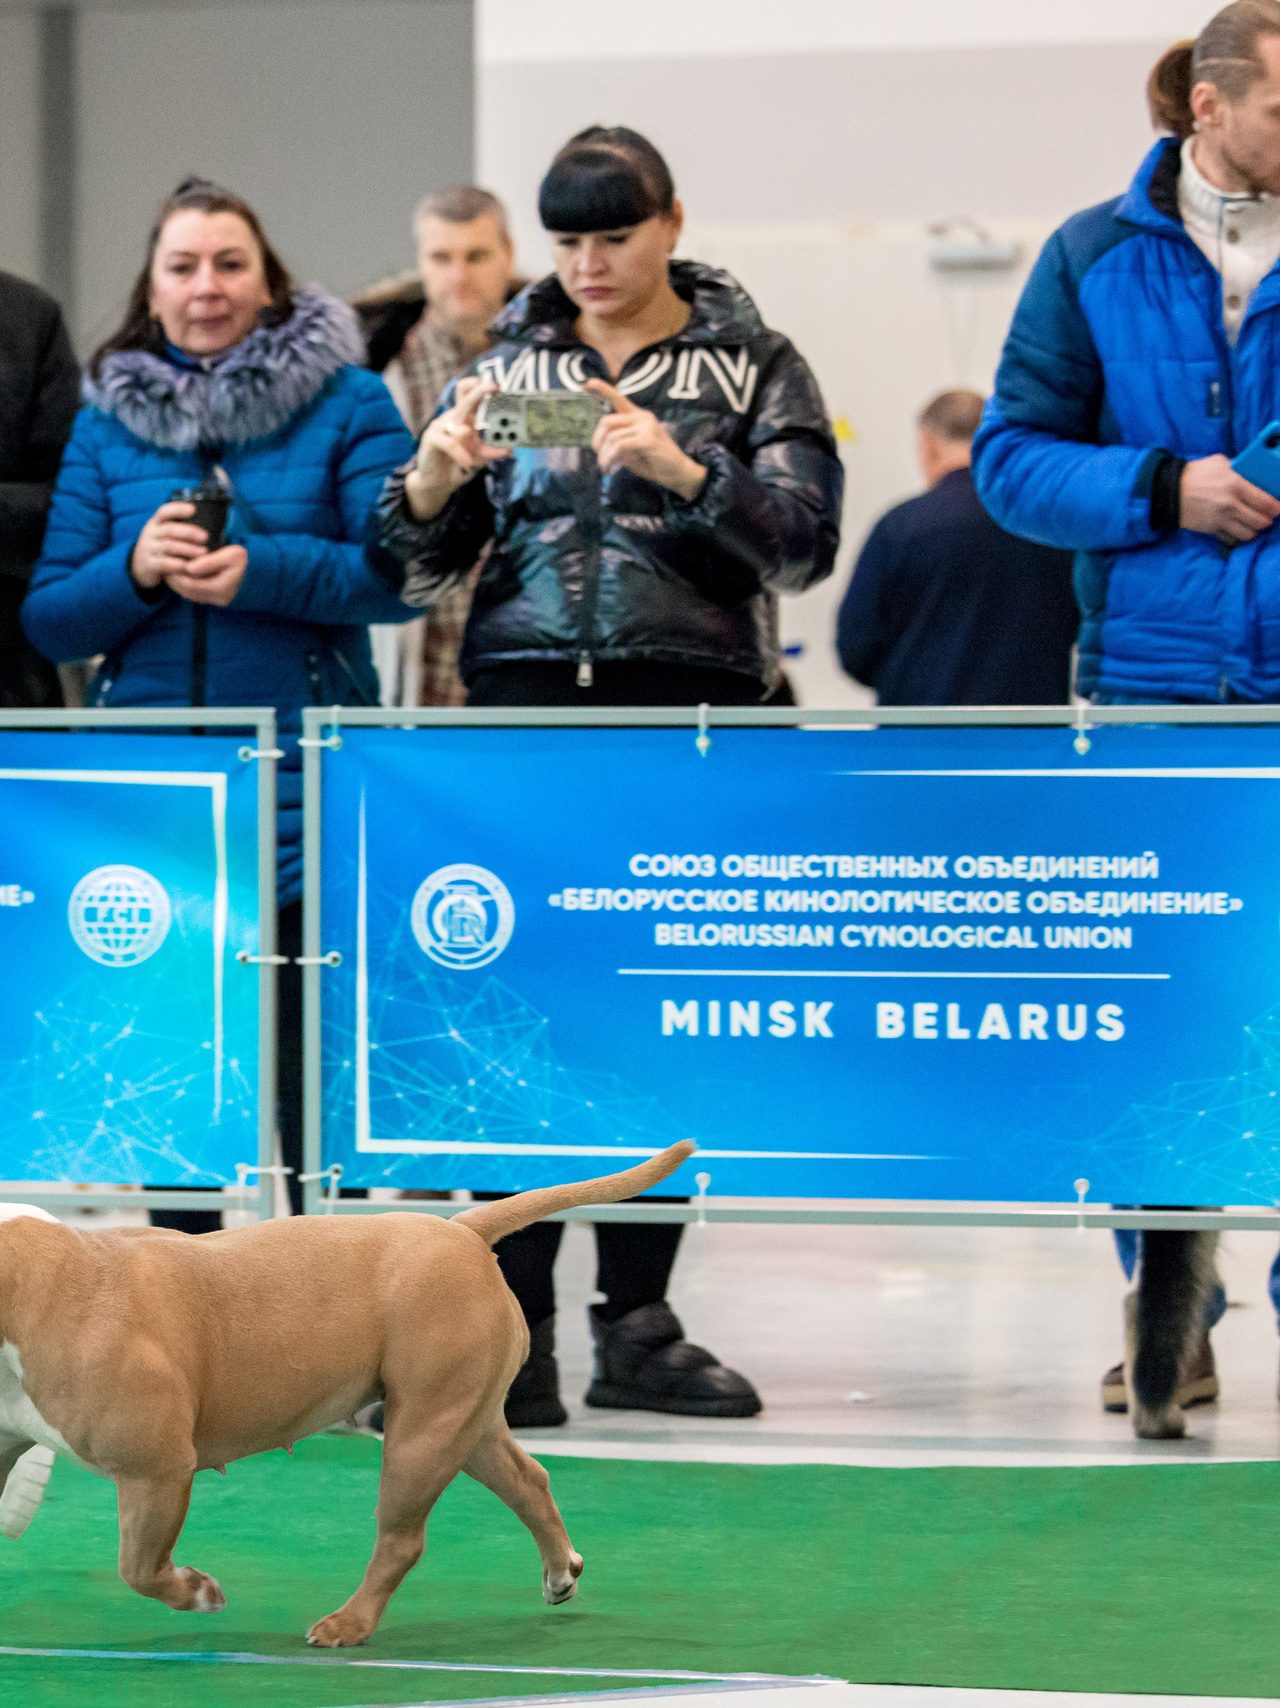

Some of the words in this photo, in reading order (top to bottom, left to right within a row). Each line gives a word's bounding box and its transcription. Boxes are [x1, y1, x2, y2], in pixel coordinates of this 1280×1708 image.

[628, 853, 717, 878] СОЮЗ
[721, 854, 949, 881] ОБЩЕСТВЕННЫХ
[953, 850, 1160, 882] ОБЪЕДИНЕНИЙ
[548, 887, 759, 913] «БЕЛОРУССКОЕ
[764, 889, 1021, 914] КИНОЛОГИЧЕСКОЕ
[1026, 890, 1244, 918] ОБЪЕДИНЕНИЕ»
[654, 922, 834, 947] BELORUSSIAN
[840, 924, 1039, 949] CYNOLOGICAL
[1044, 926, 1132, 949] UNION
[662, 999, 834, 1038] MINSK
[876, 1001, 1125, 1041] BELARUS
